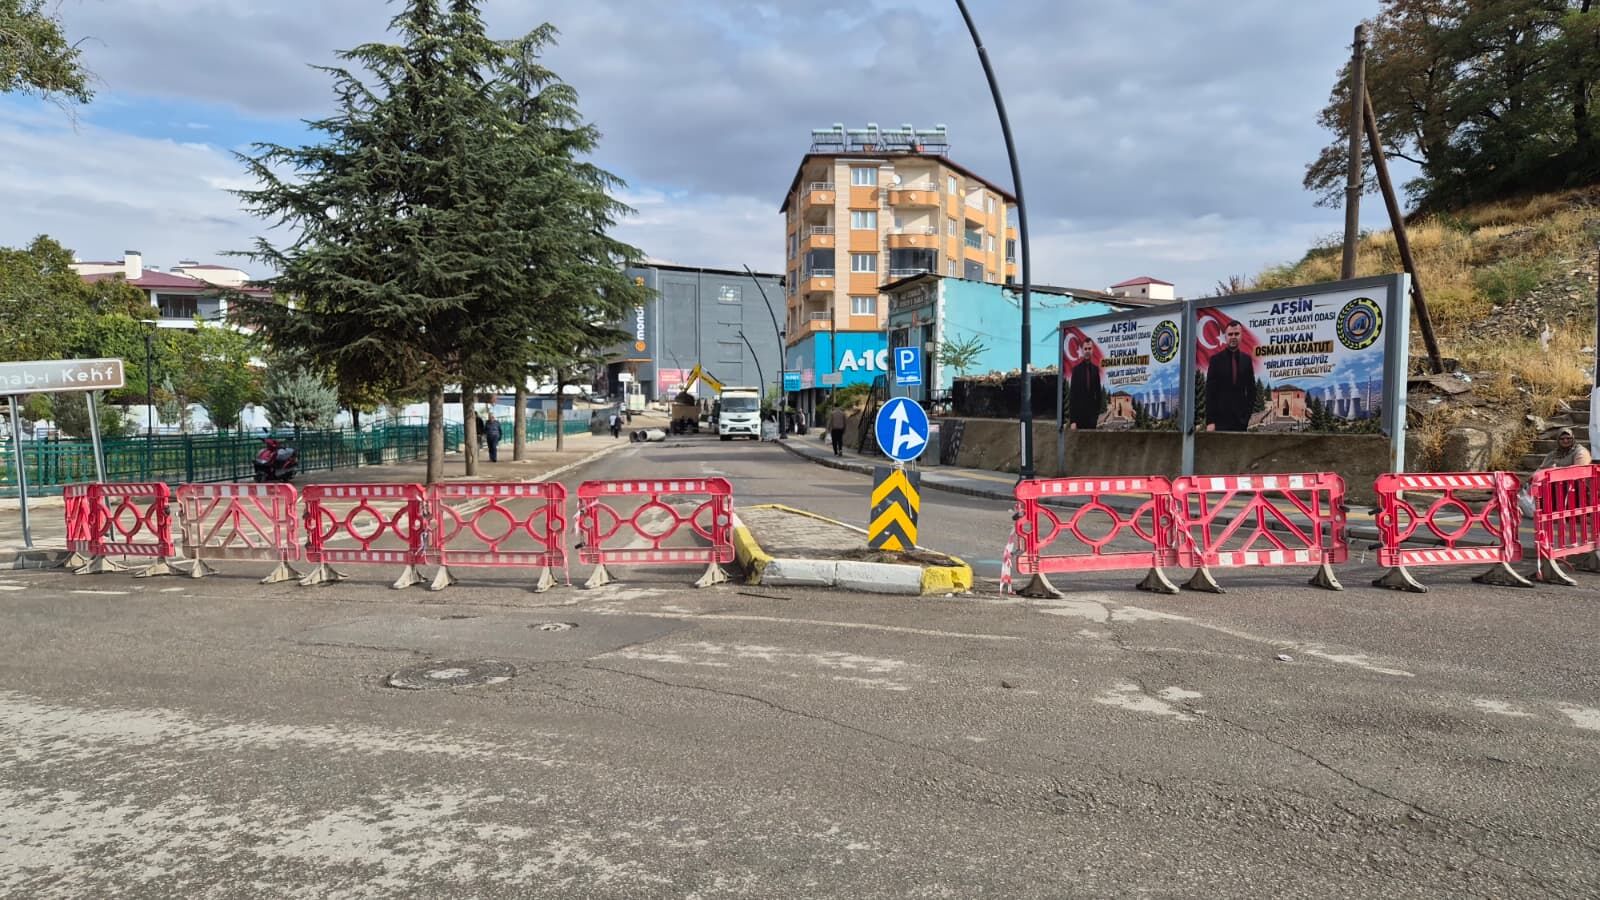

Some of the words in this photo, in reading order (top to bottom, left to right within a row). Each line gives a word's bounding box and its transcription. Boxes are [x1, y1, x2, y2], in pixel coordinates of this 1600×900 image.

[1270, 298, 1313, 315] AFŞİN
[1110, 320, 1137, 334] AFŞİN
[1249, 317, 1276, 328] TİCARET
[1277, 316, 1287, 325] VE
[1287, 313, 1313, 324] SANAYİ
[1314, 311, 1336, 321] ODASI
[1270, 332, 1314, 345] FURKAN
[1110, 348, 1138, 358] FURKAN
[1255, 344, 1289, 357] OSMAN
[1289, 341, 1330, 354] KARATUT
[900, 350, 915, 370] P
[61, 367, 113, 383] Kehf
